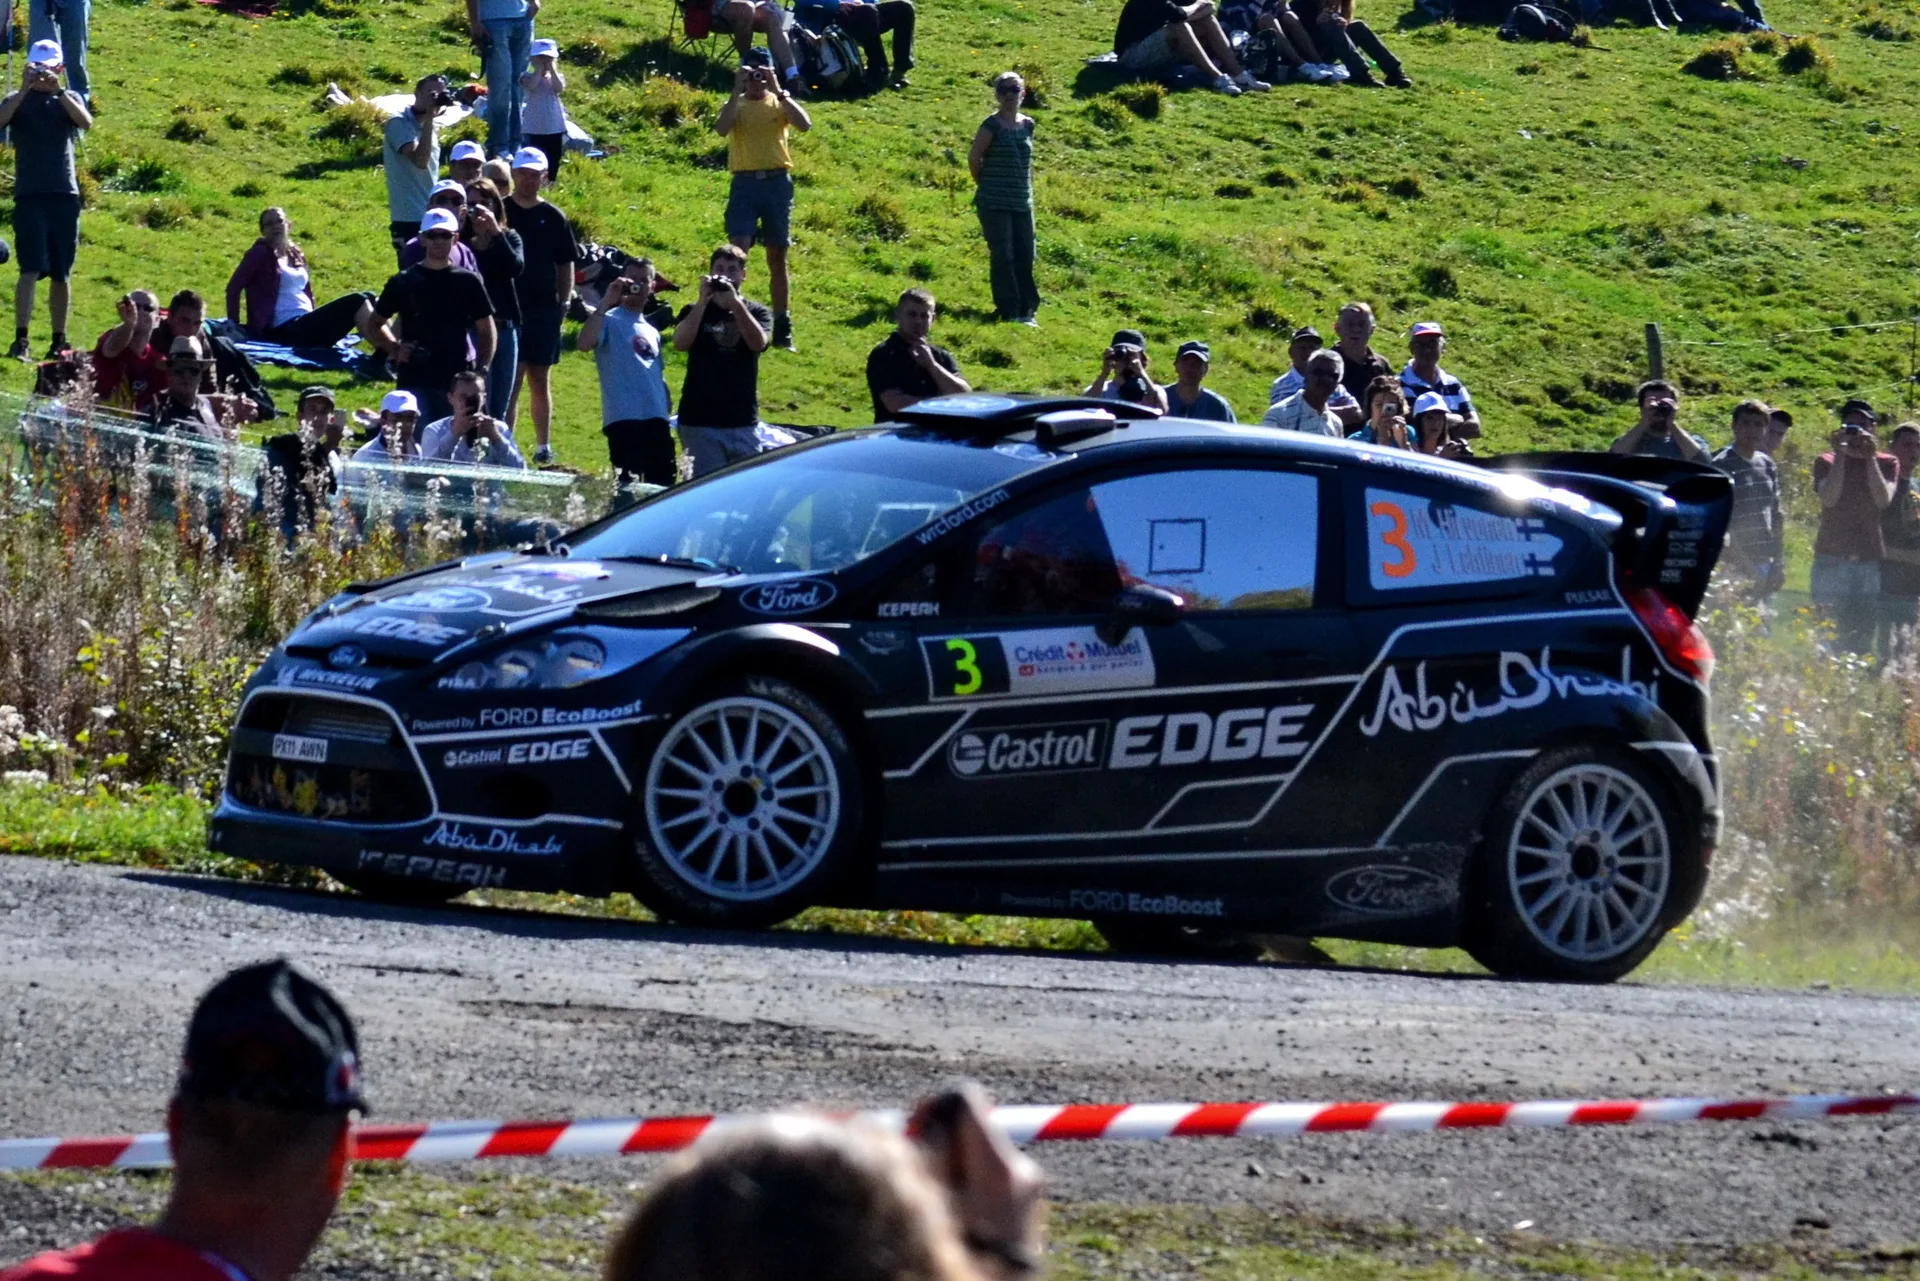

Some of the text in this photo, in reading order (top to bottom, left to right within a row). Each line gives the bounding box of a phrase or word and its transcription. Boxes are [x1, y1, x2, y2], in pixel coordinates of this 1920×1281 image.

[916, 488, 1011, 545] wrcford.com
[1370, 502, 1417, 577] 3
[758, 581, 818, 610] Ford
[877, 602, 940, 617] ICEPEAK
[946, 639, 982, 695] 3
[413, 699, 643, 731] Powered by FORD EcoBoost
[456, 737, 593, 765] Castrol EDGE
[988, 704, 1315, 771] Castrol EDGE
[1068, 888, 1126, 912] FORD
[1128, 892, 1224, 916] EcoBoost
